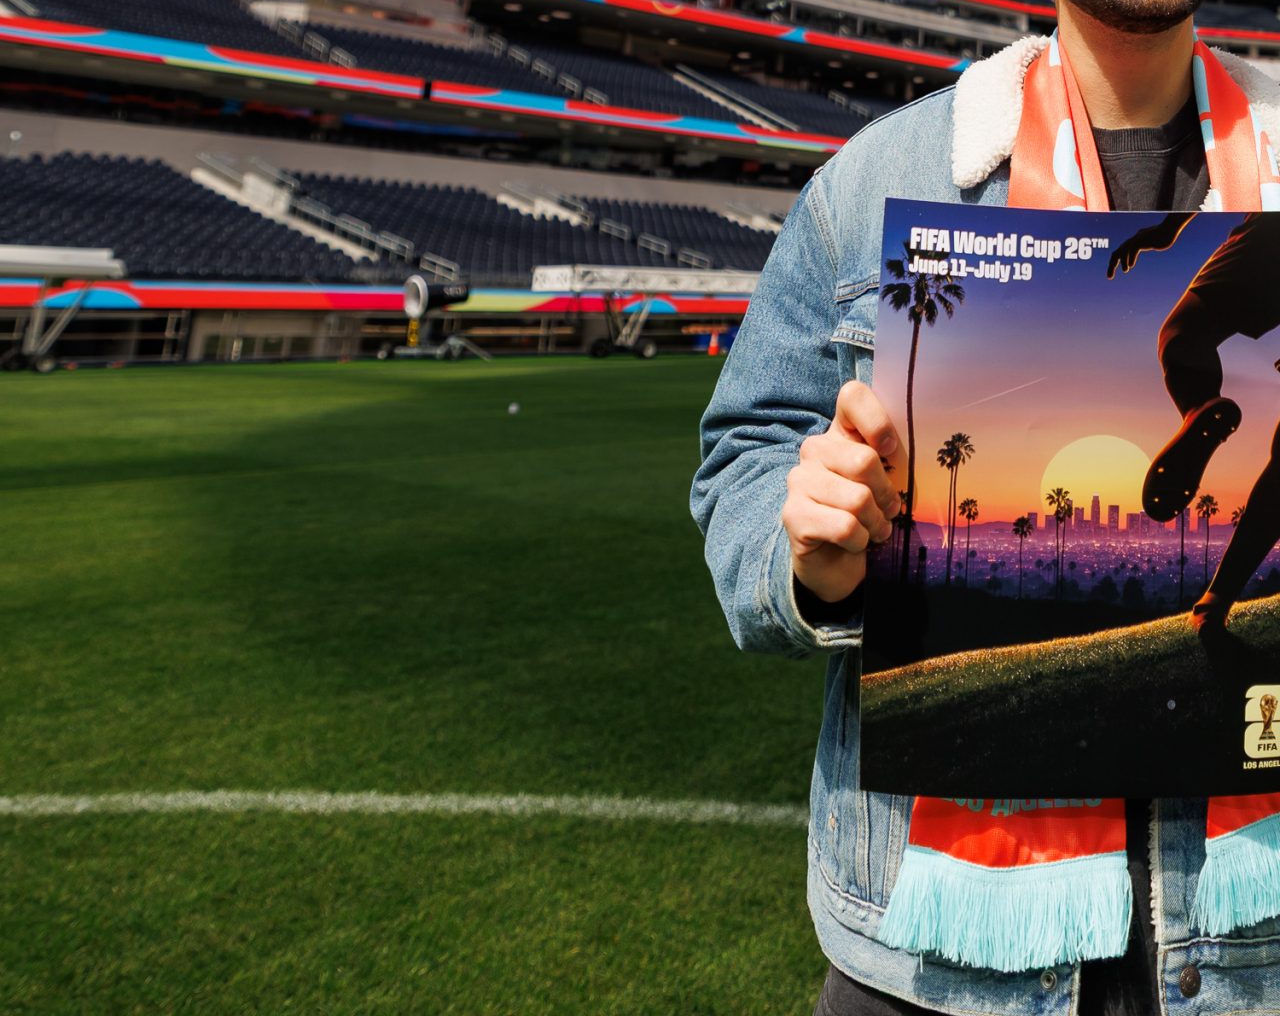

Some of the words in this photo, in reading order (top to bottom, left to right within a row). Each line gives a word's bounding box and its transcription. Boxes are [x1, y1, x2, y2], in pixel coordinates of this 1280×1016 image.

[910, 227, 950, 253] FIFA
[953, 230, 1017, 257] World
[1020, 235, 1062, 263] Cup
[908, 255, 949, 276] June
[1012, 262, 1033, 281] 19
[1257, 743, 1278, 752] FIFA
[1243, 761, 1257, 770] LOS
